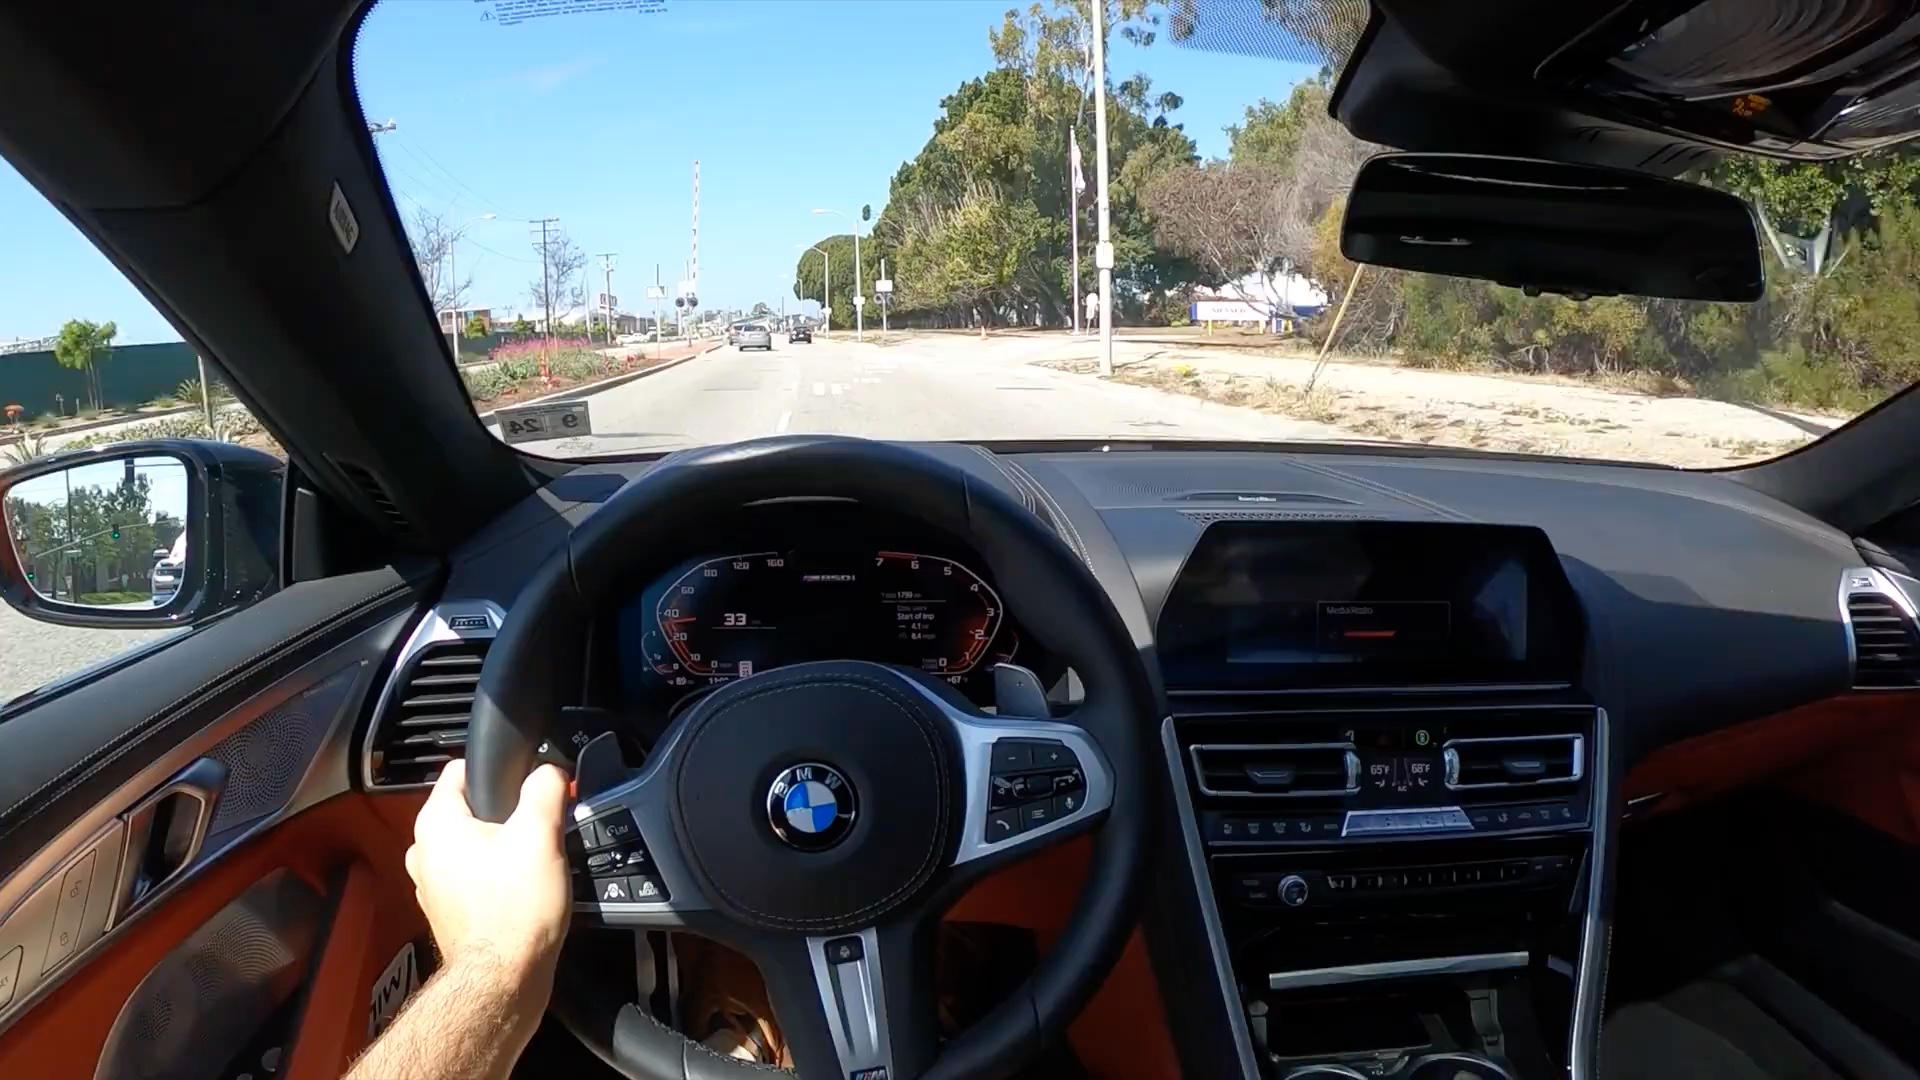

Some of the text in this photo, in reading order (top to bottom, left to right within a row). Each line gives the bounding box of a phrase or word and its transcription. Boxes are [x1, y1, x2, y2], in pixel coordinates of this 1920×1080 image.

[732, 561, 750, 570] 120
[766, 559, 784, 567] 160
[875, 557, 884, 567] 7
[910, 561, 920, 570] 6
[703, 569, 718, 577] 80
[943, 566, 953, 576] 5
[681, 586, 695, 594] 60
[970, 583, 979, 592] 4
[663, 608, 680, 618] 40
[986, 607, 995, 617] 3
[723, 613, 747, 626] 33
[672, 632, 688, 641] 20
[974, 629, 985, 640] 2
[689, 653, 701, 662] 10
[711, 660, 718, 669] 0
[938, 658, 947, 667] 0
[774, 766, 842, 799] BMW
